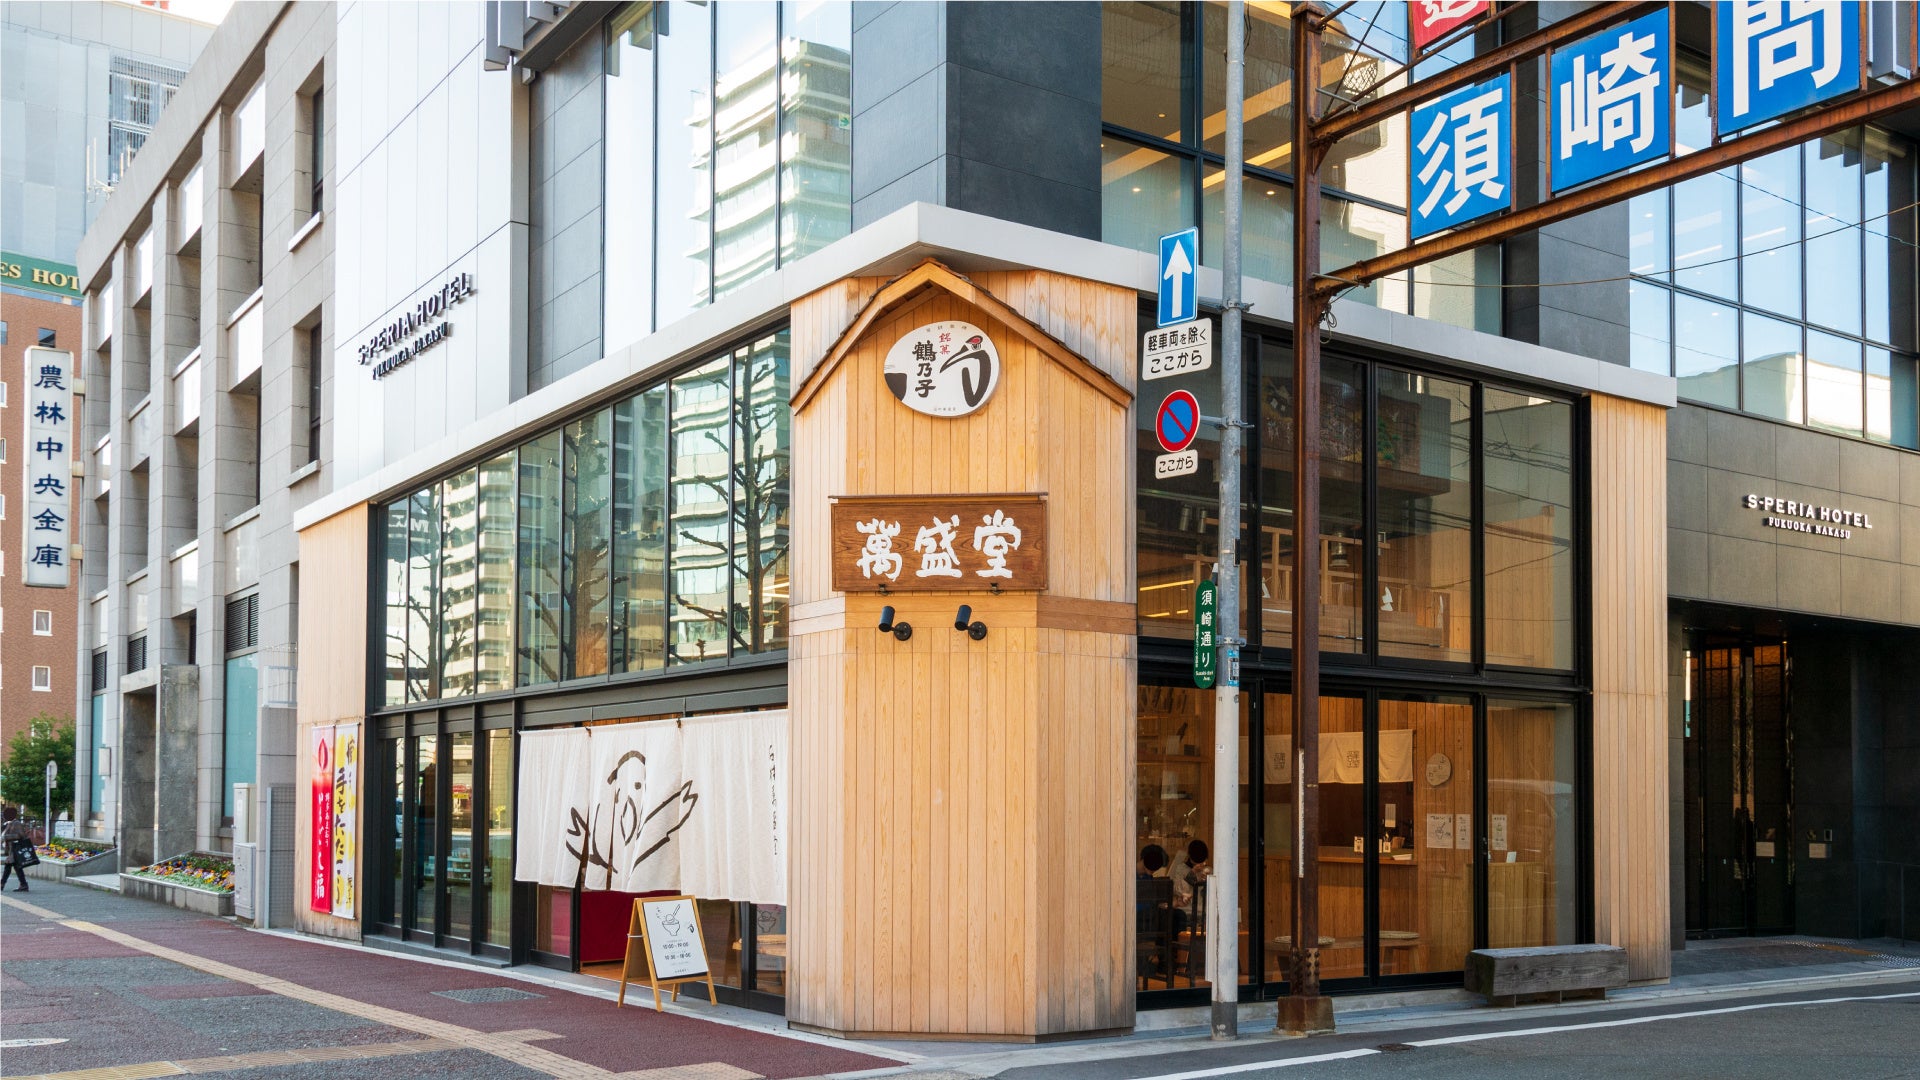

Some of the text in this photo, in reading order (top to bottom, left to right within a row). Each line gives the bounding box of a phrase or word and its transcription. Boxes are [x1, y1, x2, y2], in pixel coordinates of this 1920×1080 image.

[358, 273, 474, 365] S-PERIA HOTEL
[1148, 327, 1206, 352] 軽車両を除く
[373, 321, 450, 380] FUKUOKA NAKASU
[938, 332, 951, 355] 銘菓
[1150, 350, 1203, 373] ここから
[912, 340, 938, 398] 鶴乃子
[31, 364, 67, 568] 農林中央金庫
[1158, 455, 1194, 473] ここから
[1747, 494, 1873, 529] S-PERIA HOTEL
[1768, 516, 1851, 540] FUKUOKA NAKASU
[855, 509, 1022, 582] 萬盛堂
[1201, 590, 1213, 667] 須崎通り
